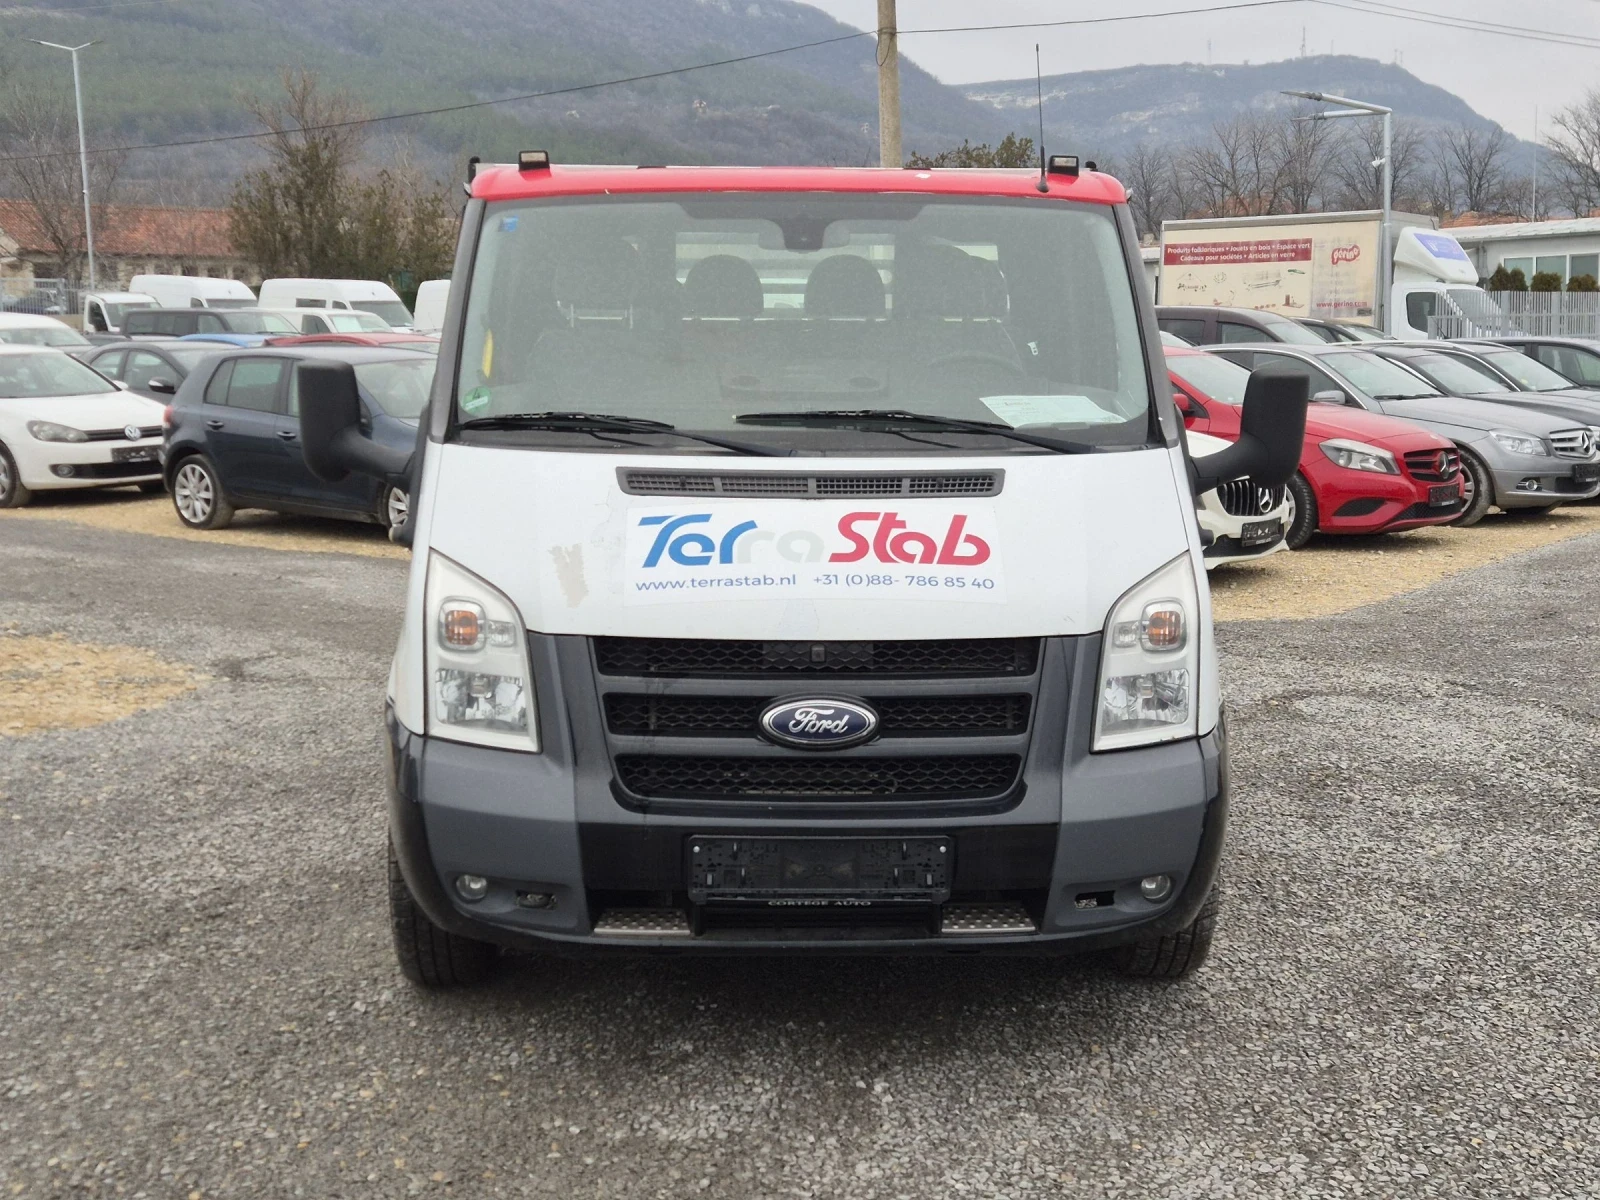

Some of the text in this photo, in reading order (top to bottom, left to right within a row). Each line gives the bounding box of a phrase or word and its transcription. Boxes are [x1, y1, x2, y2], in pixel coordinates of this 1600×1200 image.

[1230, 244, 1249, 252] Jouets
[637, 511, 991, 568] Terra Stab
[635, 573, 797, 591] www.terrastab.nl
[813, 574, 995, 590] +31 (0)88- 786 85 40
[788, 707, 849, 735] Ford
